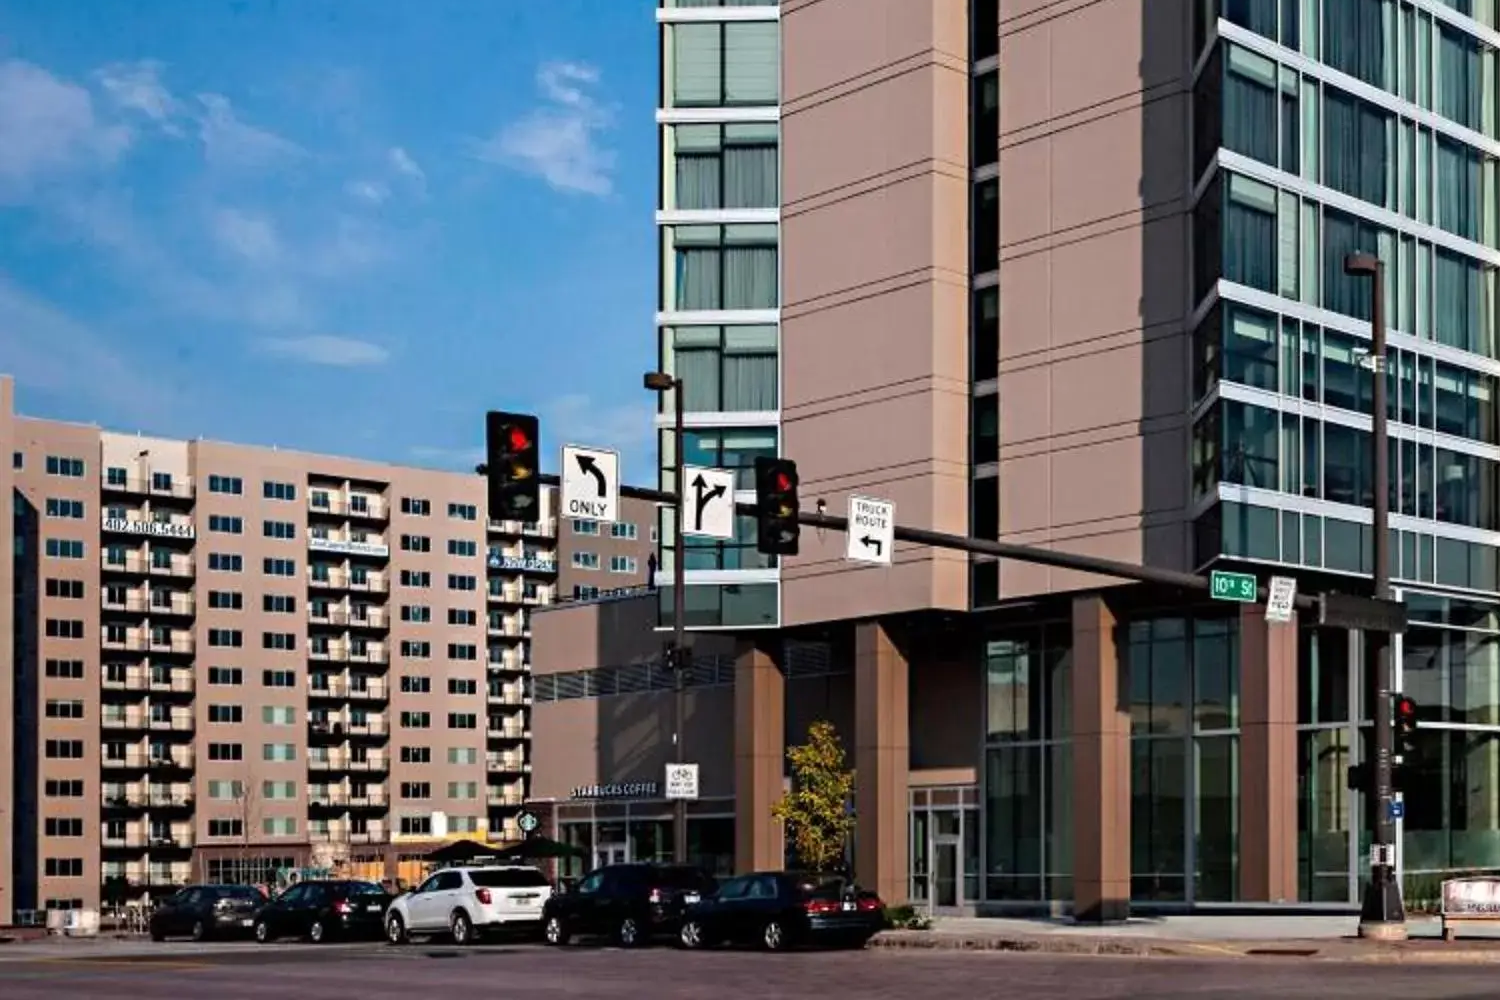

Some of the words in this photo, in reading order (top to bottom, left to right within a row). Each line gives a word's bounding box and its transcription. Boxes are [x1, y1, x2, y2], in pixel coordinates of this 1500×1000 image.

[569, 499, 607, 517] ONLY
[856, 501, 888, 516] TRUCK
[855, 514, 888, 529] ROUTE
[569, 784, 622, 798] STARBUCKS
[623, 781, 657, 796] COFFEE
